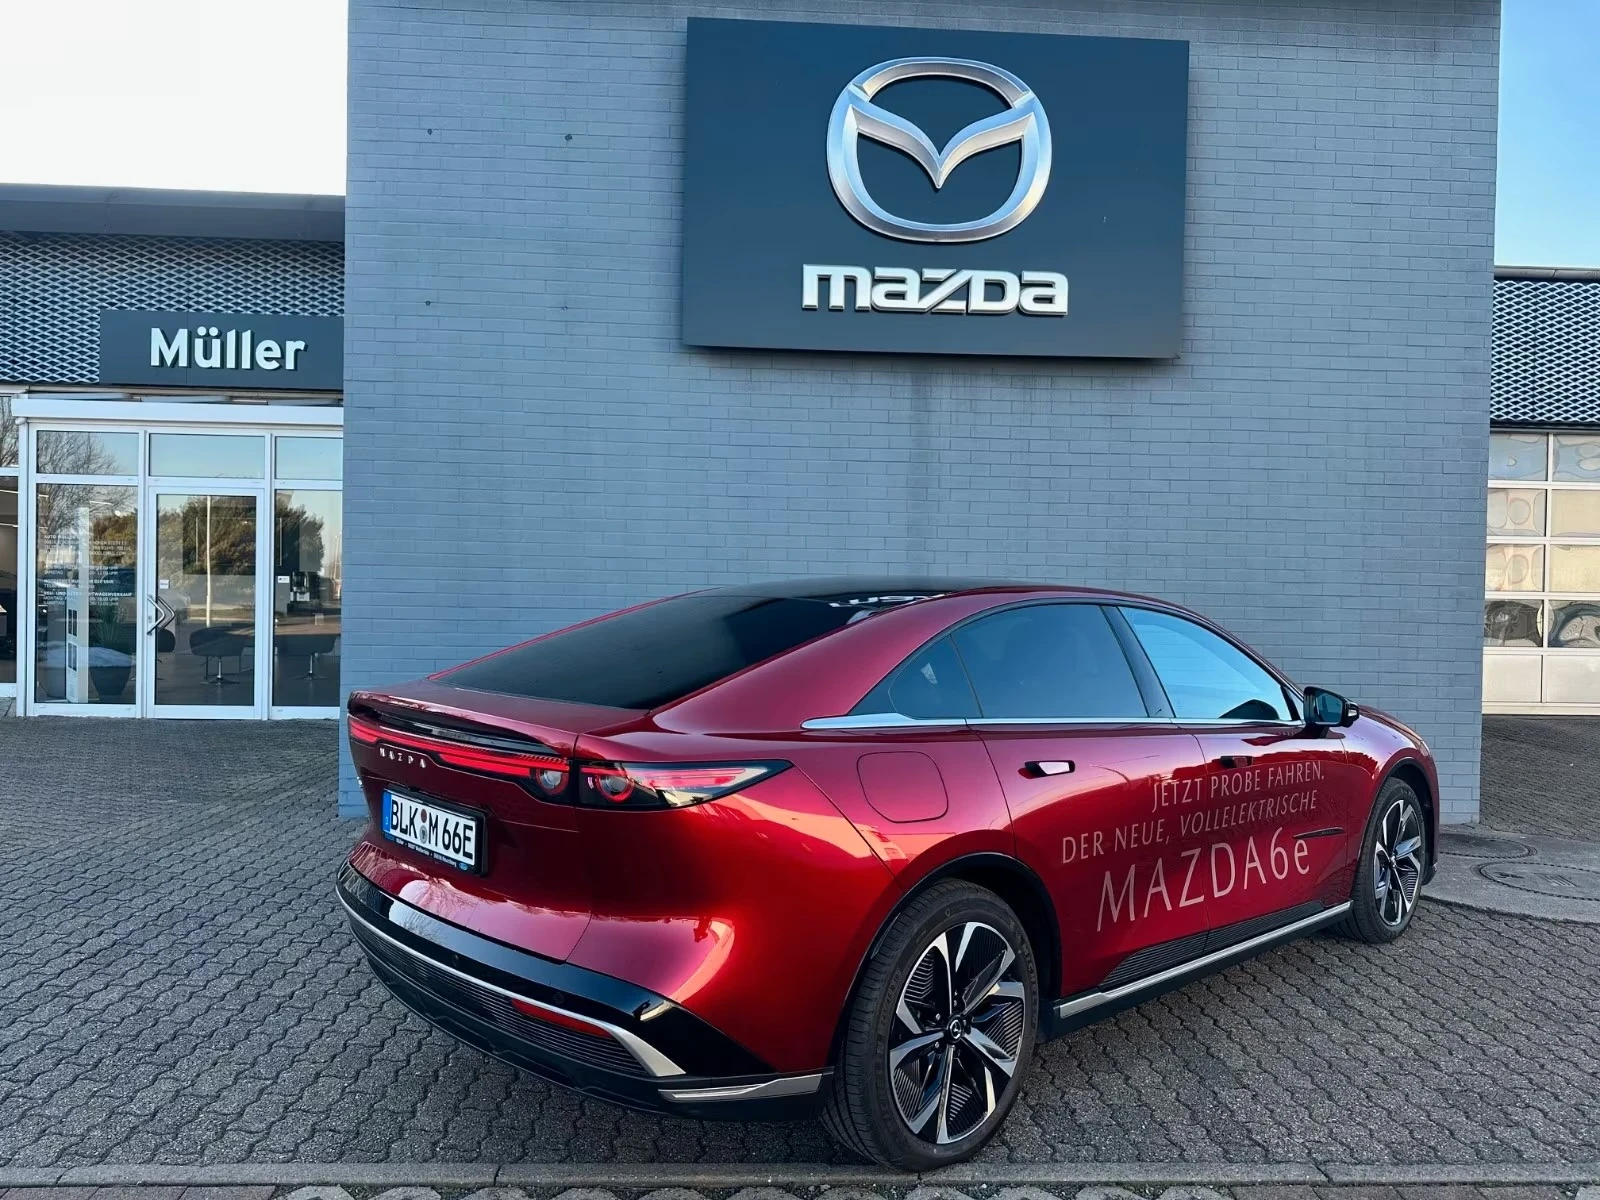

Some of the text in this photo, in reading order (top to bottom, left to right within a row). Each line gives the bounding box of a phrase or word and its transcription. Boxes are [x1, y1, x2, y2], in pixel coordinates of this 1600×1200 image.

[150, 326, 307, 370] Müller
[1152, 760, 1325, 813] JETZT PROBE FAHREN.
[390, 799, 418, 840] BLK
[428, 812, 439, 848] M
[442, 817, 474, 861] 66E
[1062, 789, 1318, 864] DER NEUE, VOLLELEKTRISCHE
[1097, 826, 1310, 932] MAZDA6e
